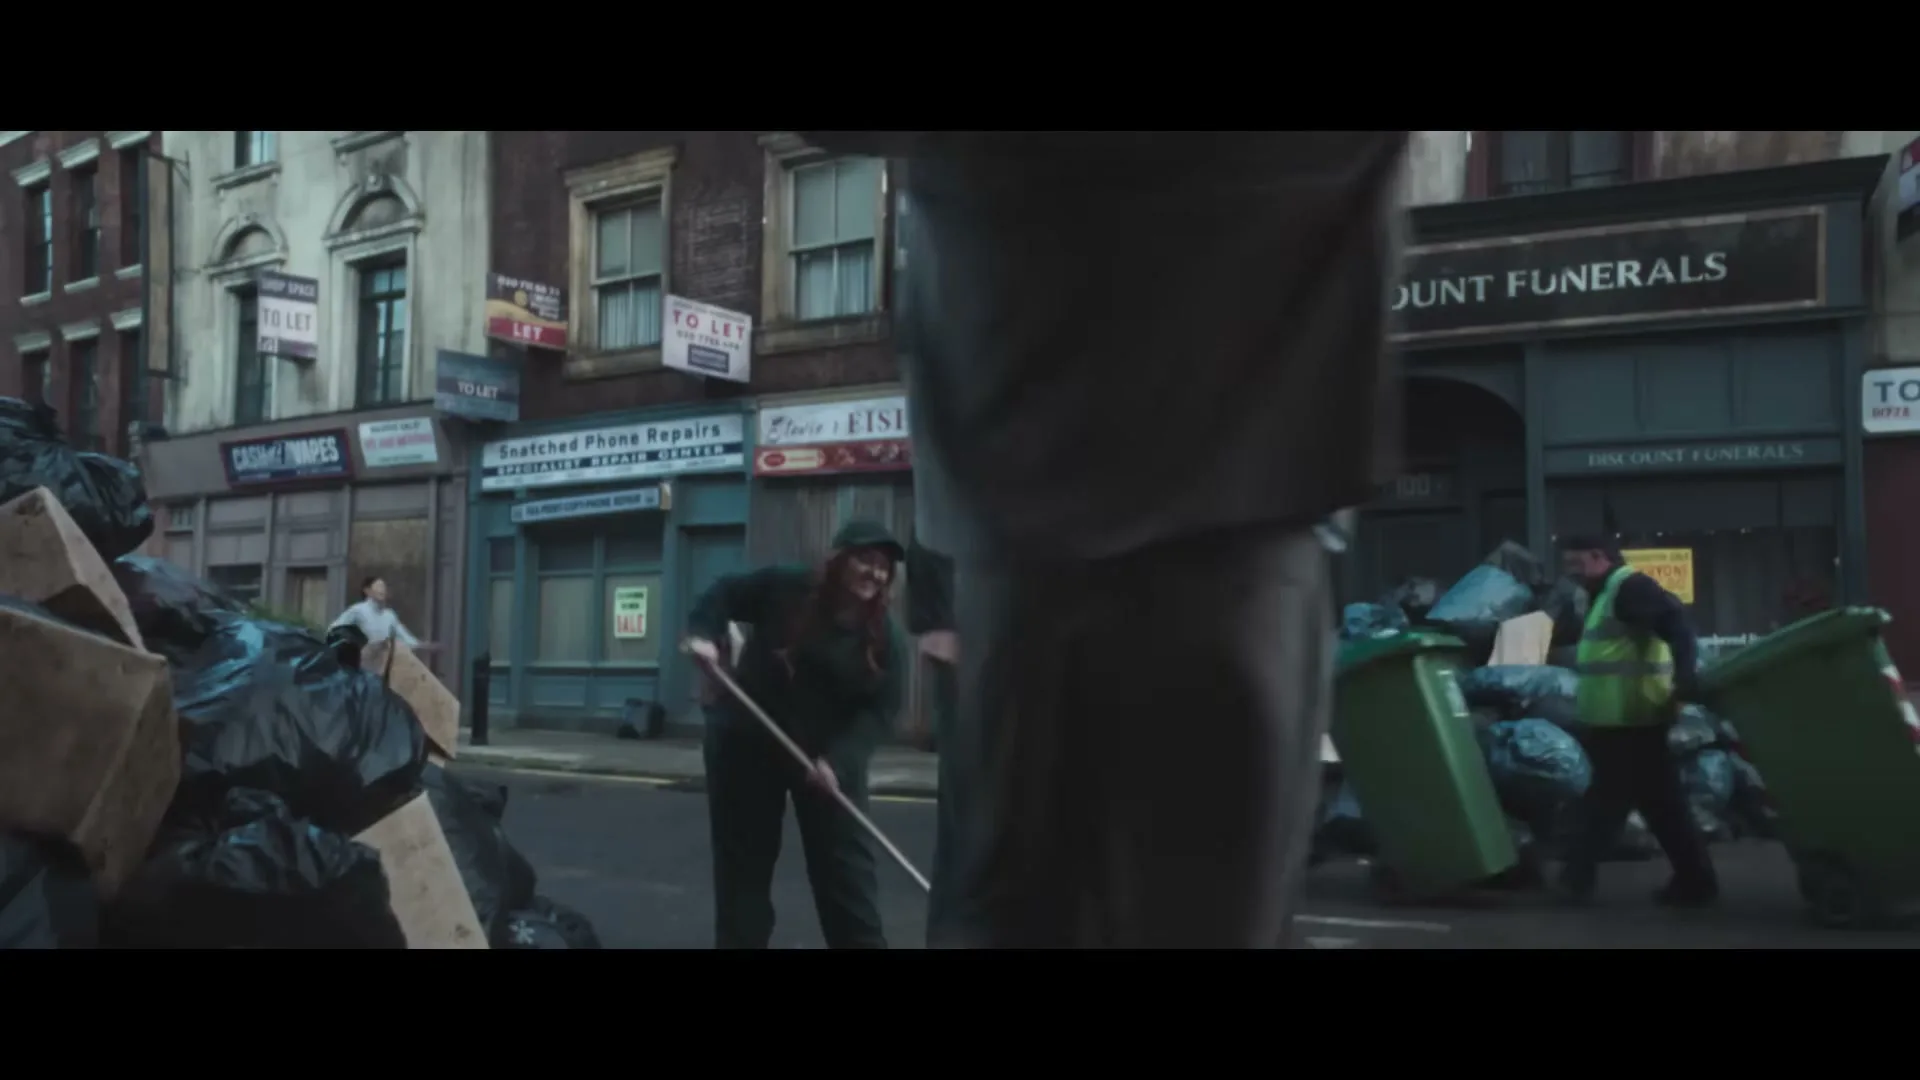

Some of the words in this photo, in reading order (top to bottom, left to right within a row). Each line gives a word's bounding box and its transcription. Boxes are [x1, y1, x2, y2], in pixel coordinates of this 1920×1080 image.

[1507, 252, 1728, 298] FUNERALS
[262, 308, 281, 328] TO
[286, 311, 312, 332] LET
[513, 322, 543, 341] LET
[673, 309, 699, 329] TO
[711, 319, 745, 340] LET
[457, 381, 475, 395] TO
[476, 384, 498, 399] LET
[1872, 379, 1920, 403] TO
[287, 435, 340, 467] VAPES
[499, 438, 579, 461] Snatched
[584, 430, 640, 451] Phone
[647, 421, 721, 446] Repairs
[497, 458, 582, 477] SPECIALIST
[591, 451, 647, 467] REPAIR
[658, 444, 724, 461] CENTER
[1588, 447, 1686, 467] DISCOUNT
[1692, 443, 1804, 462] FUNERALS
